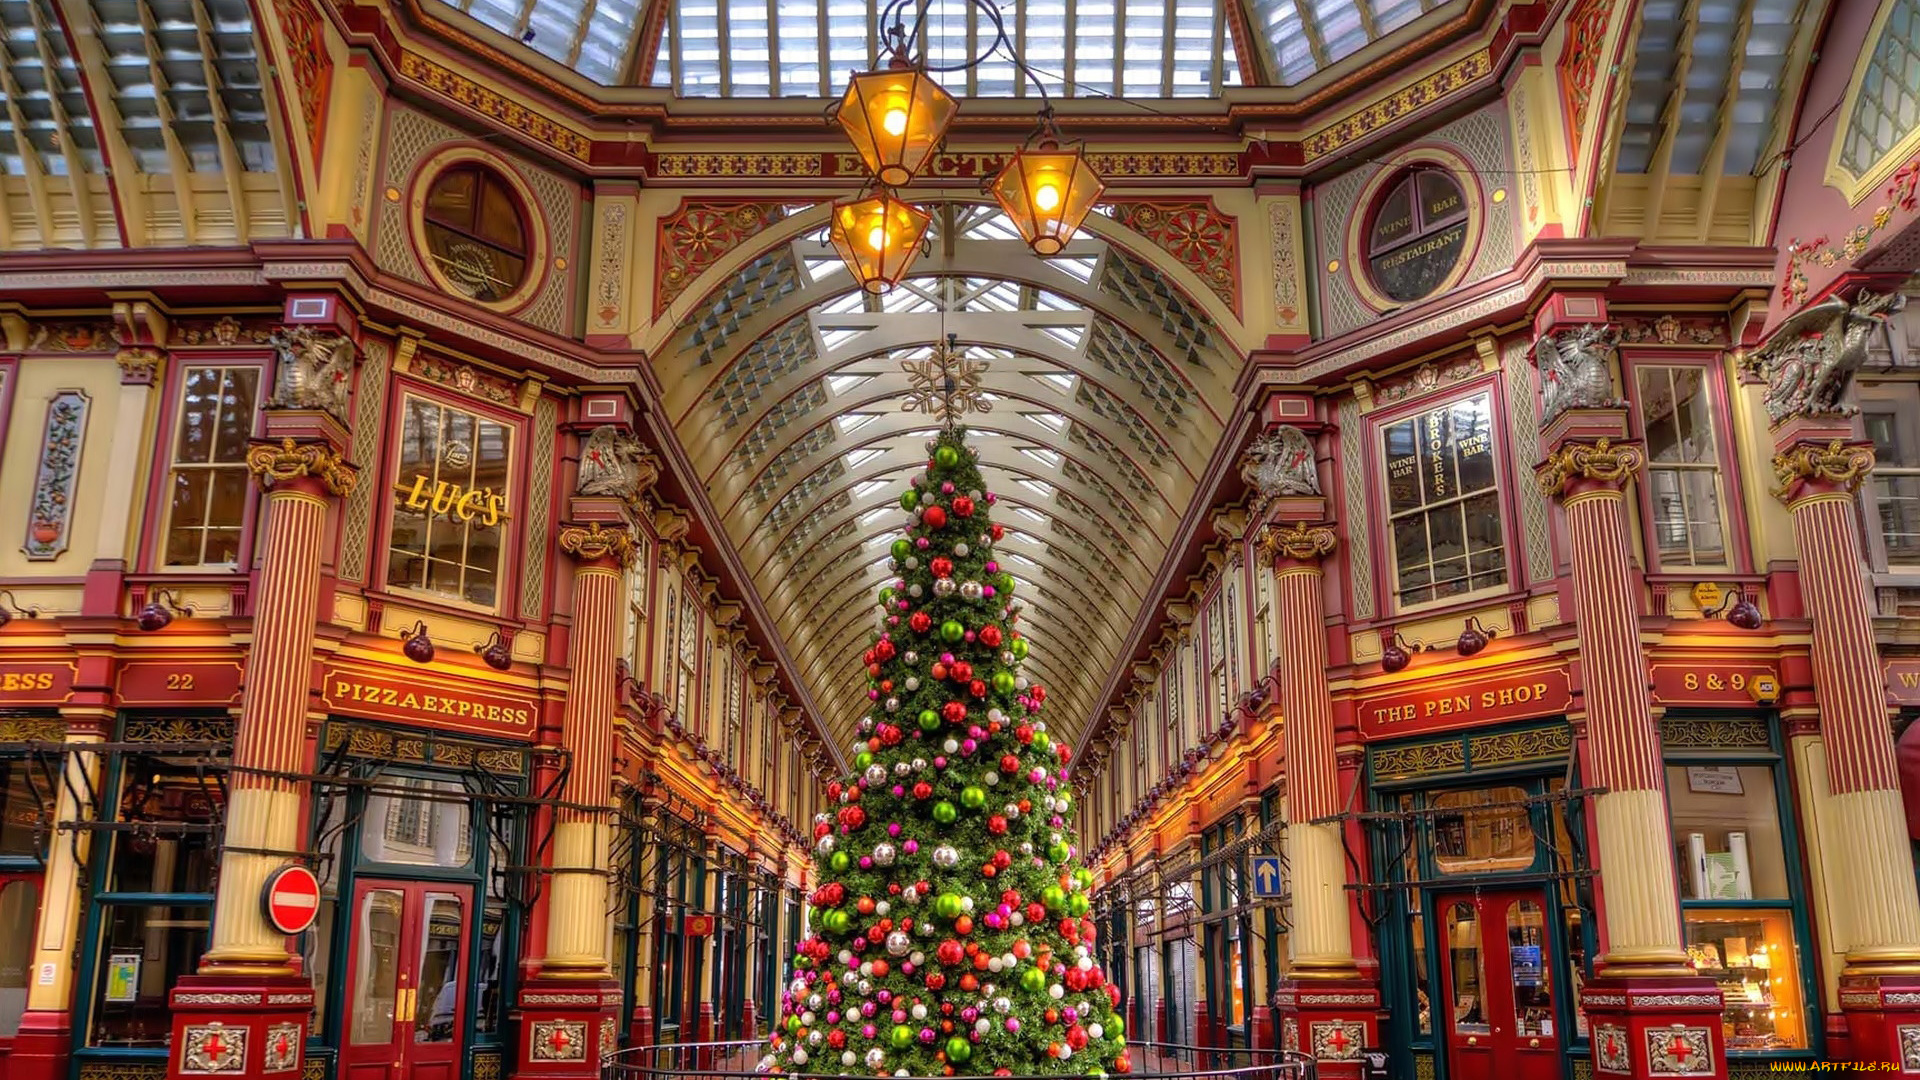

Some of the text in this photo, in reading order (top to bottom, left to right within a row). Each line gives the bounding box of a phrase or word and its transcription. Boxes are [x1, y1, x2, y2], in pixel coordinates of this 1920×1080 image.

[1379, 195, 1458, 236] WINE BAR
[1382, 229, 1462, 269] RESTAURANT
[1459, 433, 1488, 449] WINE
[1463, 444, 1485, 457] BAR
[1389, 455, 1416, 470] WINE
[1393, 466, 1414, 478] BAR
[405, 474, 504, 526] LUC'S
[0, 673, 53, 691] ESS
[167, 674, 194, 690] 22
[1684, 673, 1745, 690] 8 & 9
[335, 681, 528, 725] PIZZAEXPRESS
[1374, 683, 1548, 724] THE PEN SHOP
